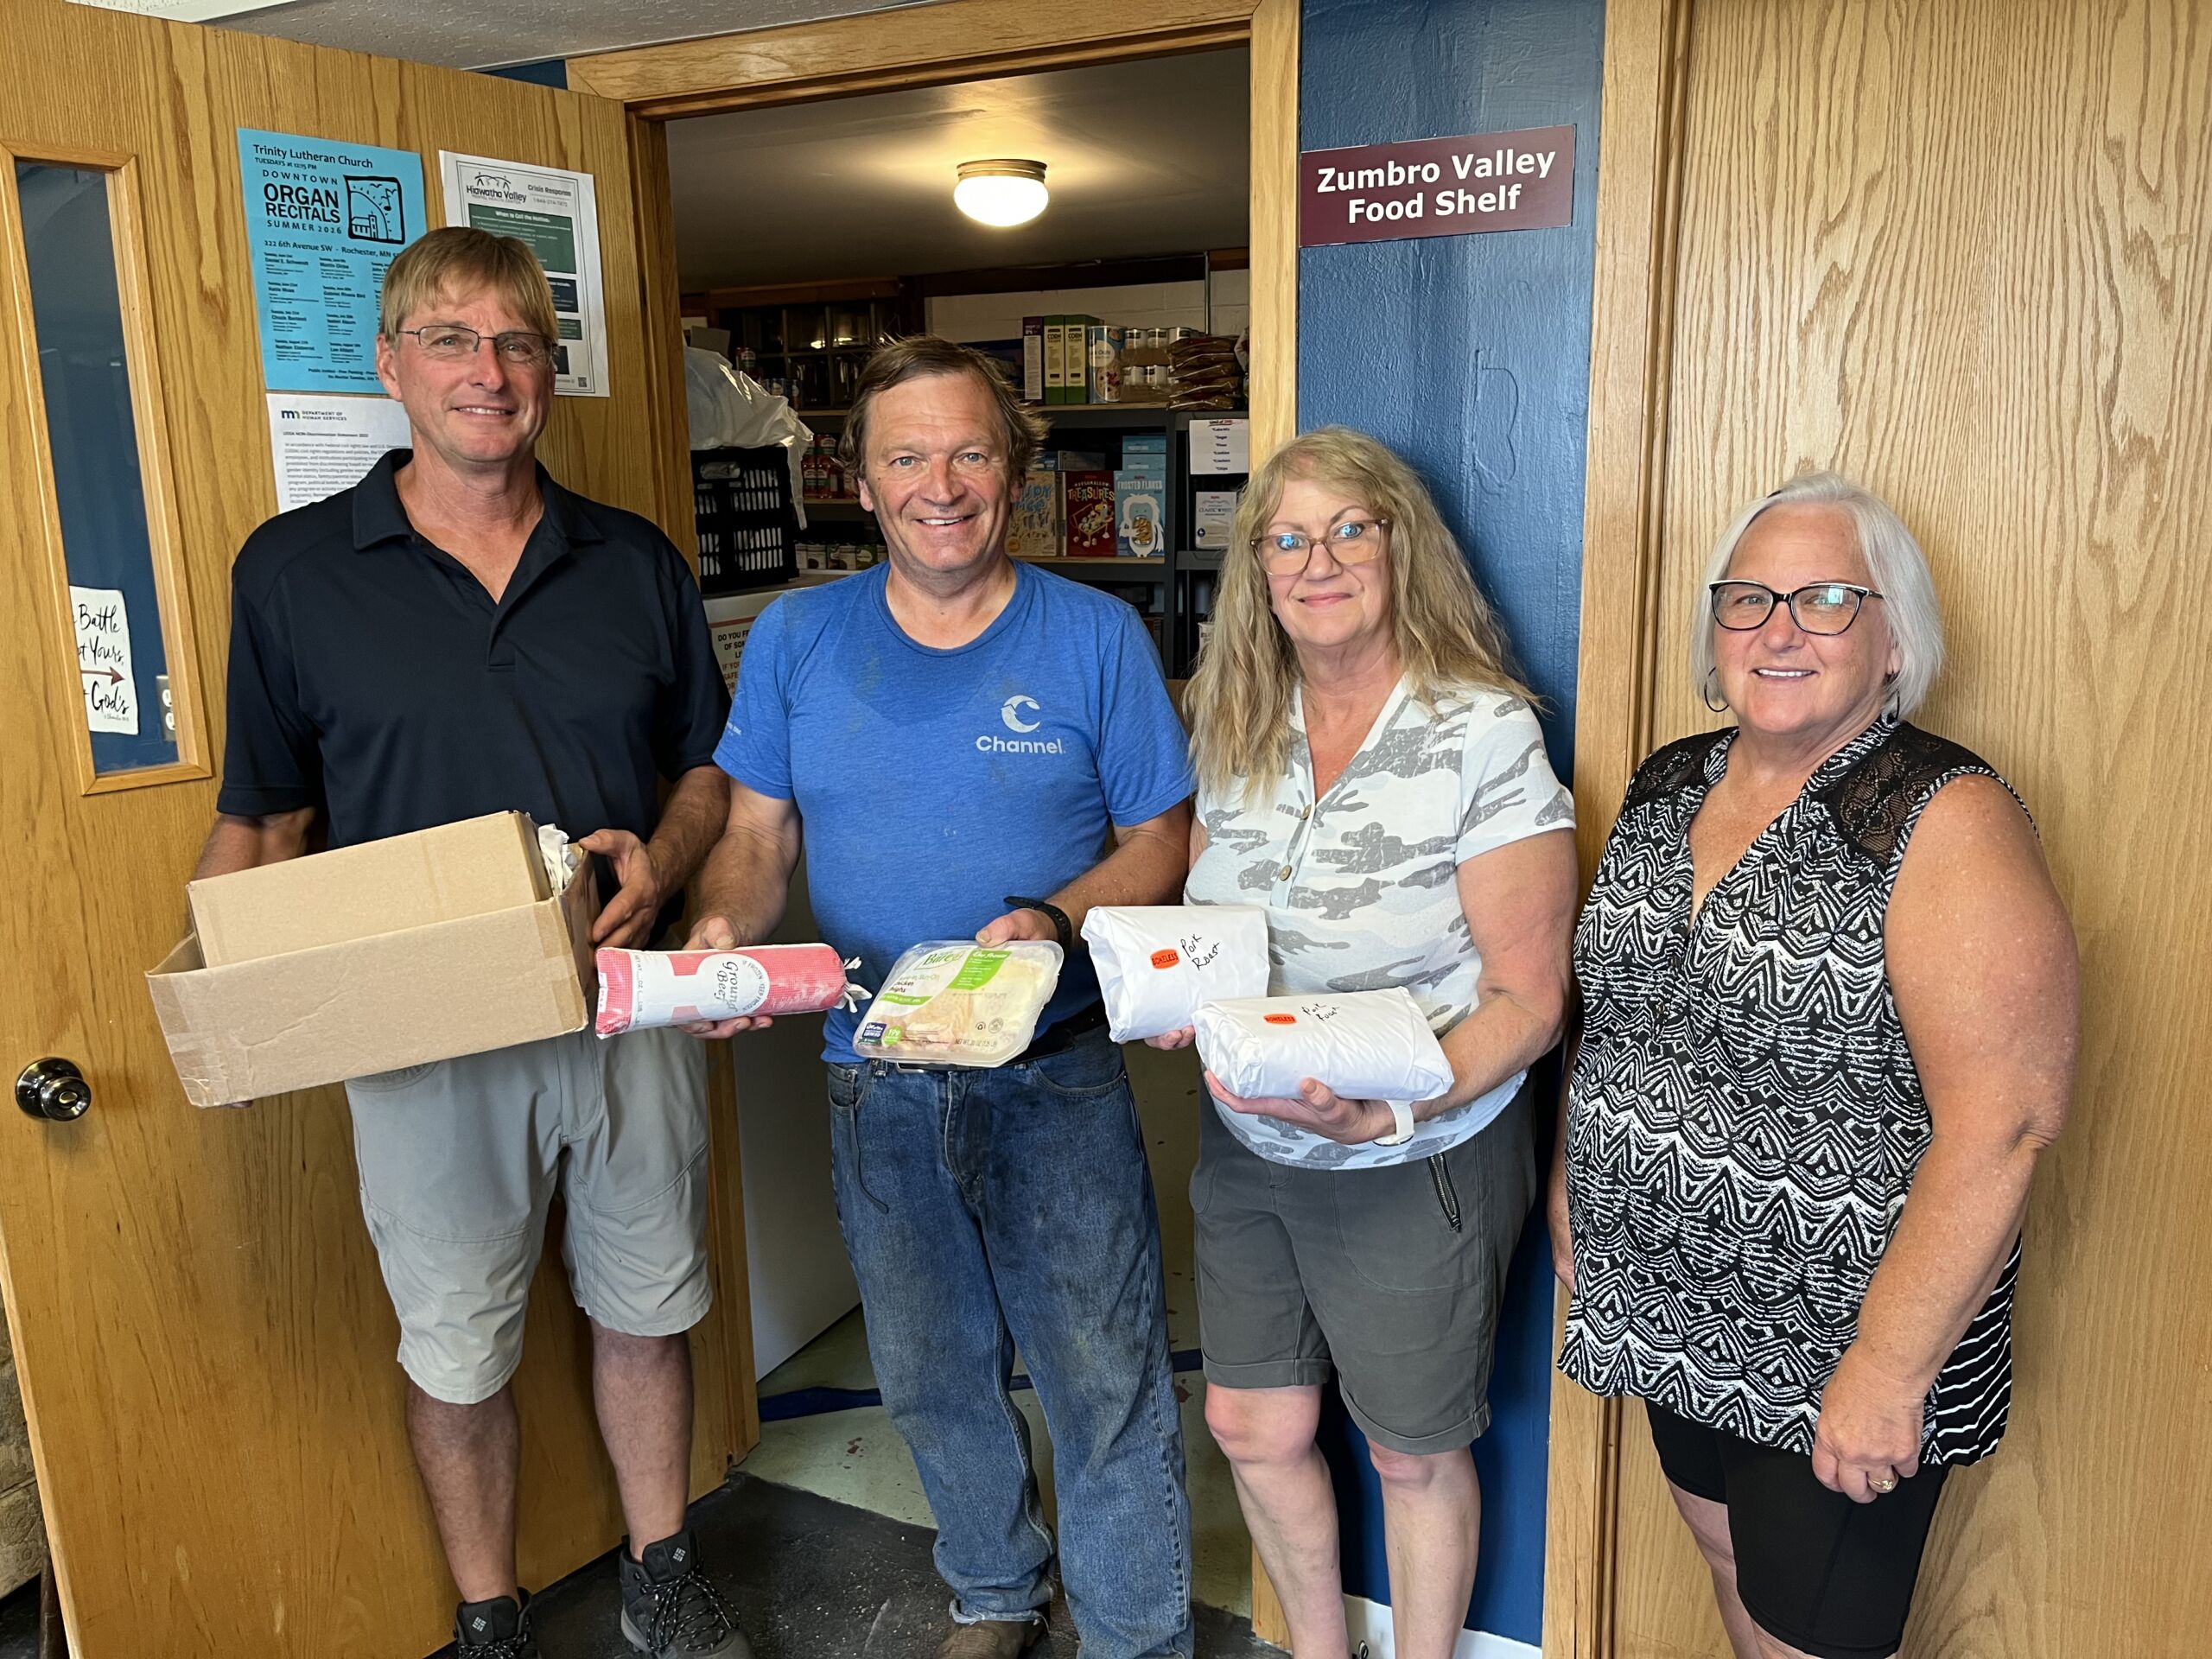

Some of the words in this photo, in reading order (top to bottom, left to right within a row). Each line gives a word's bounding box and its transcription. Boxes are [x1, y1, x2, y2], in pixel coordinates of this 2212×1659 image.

[253, 144, 287, 159] Trinity
[290, 149, 335, 163] Lutheran
[339, 156, 373, 168] Church
[254, 157, 285, 167] TUESDAYS
[263, 169, 338, 185] DOWNTOWN
[1318, 161, 1440, 193] Zumbro
[1452, 149, 1556, 180] Valley
[264, 183, 339, 208] ORGAN
[467, 185, 502, 199] Hiawatha
[504, 190, 527, 203] Valley
[1349, 192, 1424, 224] Food
[1435, 184, 1522, 216] Shelf
[265, 202, 340, 223] RECITALS
[267, 219, 315, 232] SUMMER
[292, 242, 320, 251] Avenue
[340, 246, 378, 257] Rochester,
[1067, 486, 1116, 502] TREASURES
[79, 604, 121, 634] Battle
[92, 680, 129, 715] God's
[976, 735, 1063, 754] Channel
[1180, 934, 1202, 958] Pork
[1192, 943, 1221, 971] Roast
[714, 970, 728, 1002] Beef
[722, 961, 739, 1012] Ground
